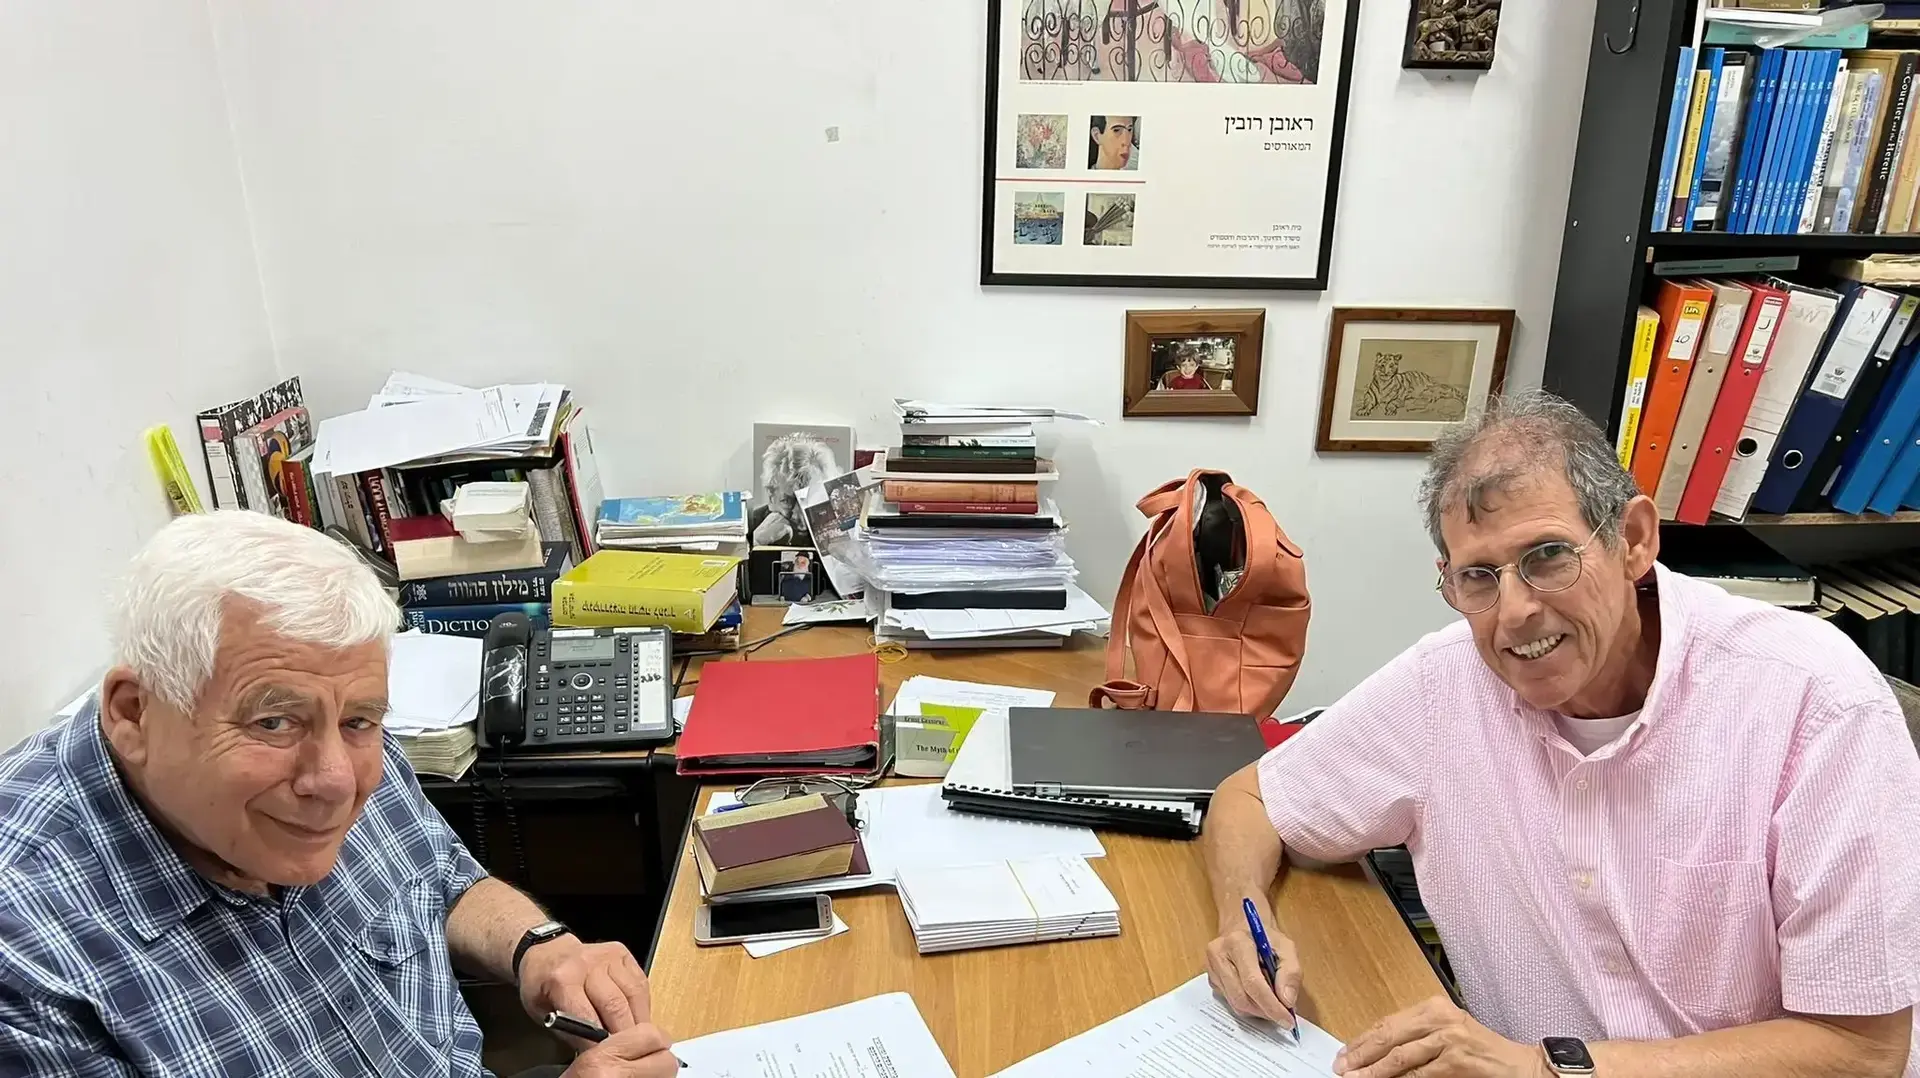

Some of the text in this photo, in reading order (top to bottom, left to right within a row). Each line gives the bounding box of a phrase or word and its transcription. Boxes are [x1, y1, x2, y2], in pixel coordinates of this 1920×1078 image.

[1894, 75, 1911, 122] Courtier
[1224, 116, 1314, 135] ראובן רובין
[1264, 142, 1312, 151] המאורסים
[1880, 142, 1895, 180] Heretic
[448, 580, 488, 598] ההווה
[492, 574, 529, 600] מילון
[428, 618, 492, 634] DICTIO
